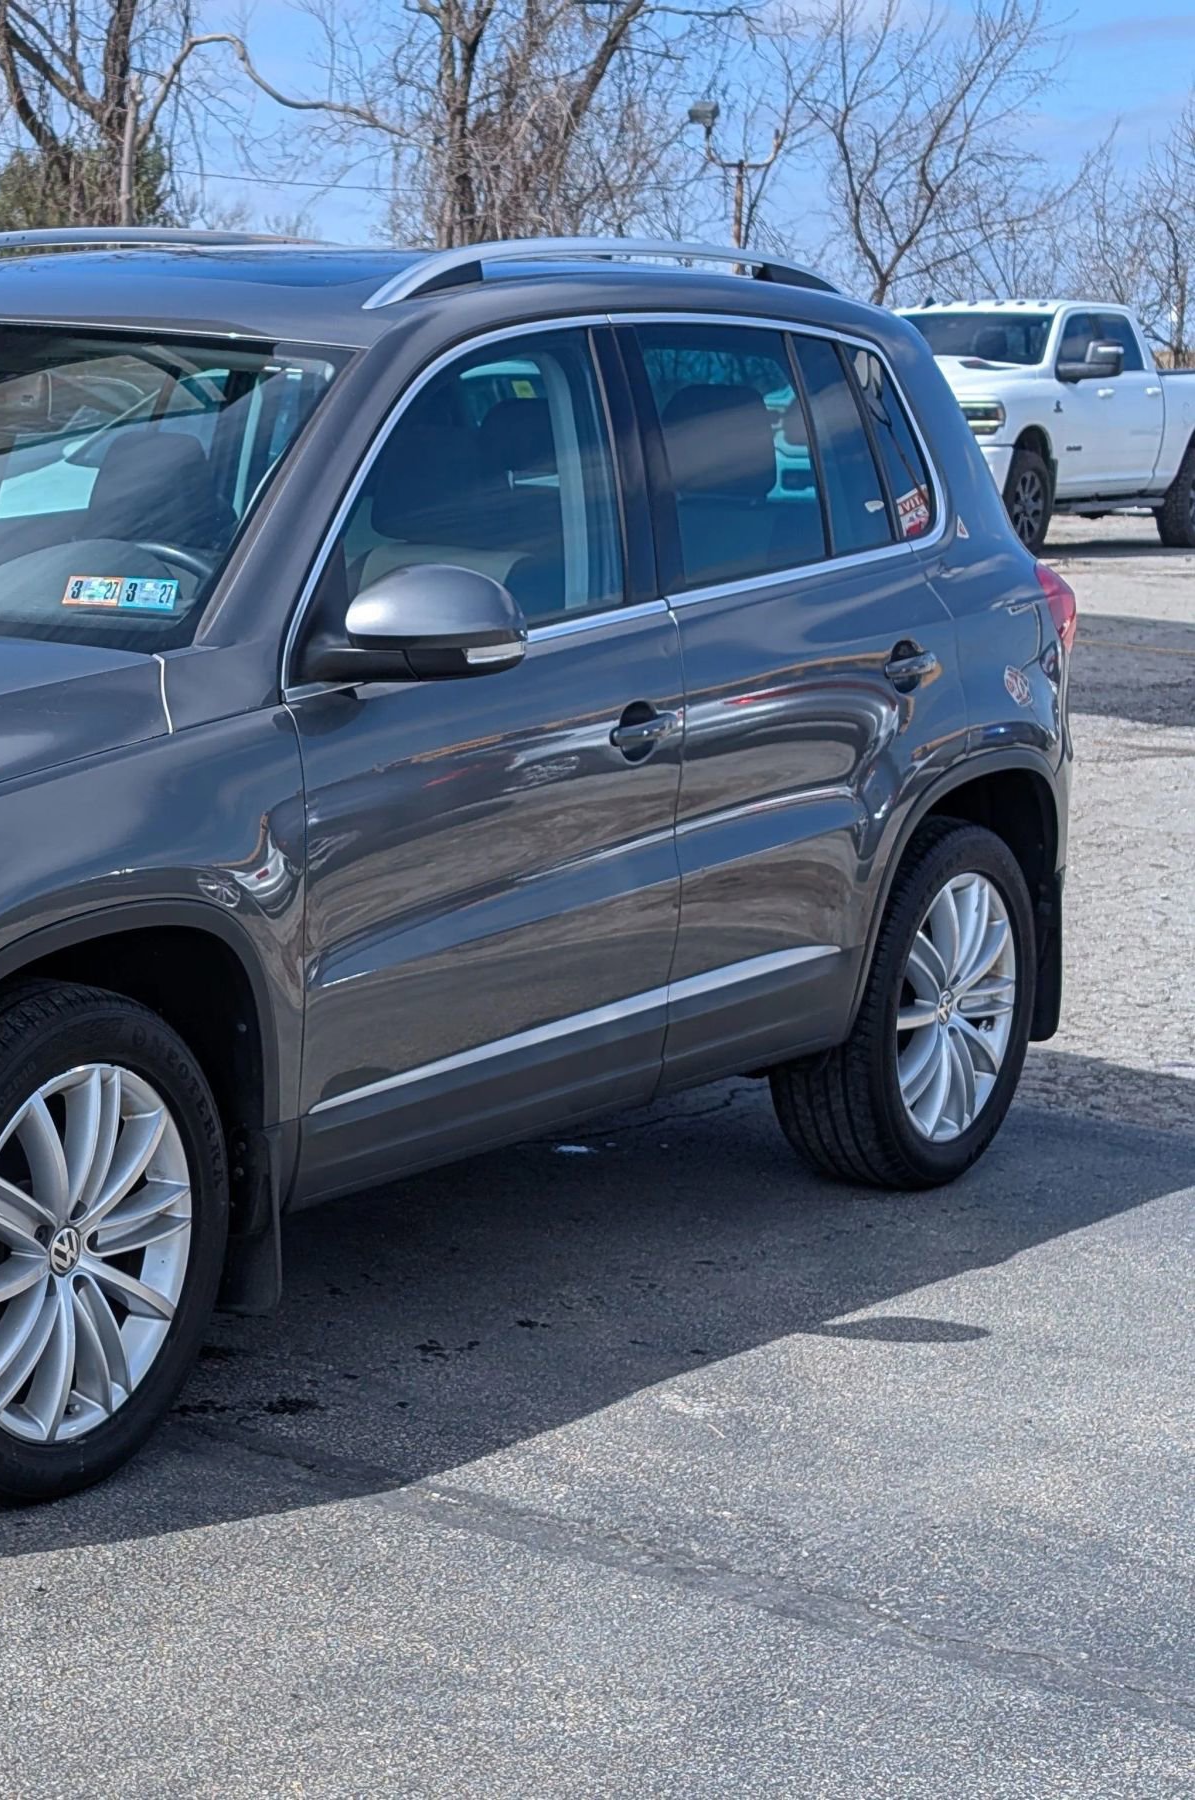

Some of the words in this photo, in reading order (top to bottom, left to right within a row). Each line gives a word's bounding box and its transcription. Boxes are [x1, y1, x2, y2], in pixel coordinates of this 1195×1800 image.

[70, 580, 84, 599] 3
[103, 581, 119, 600] 27
[125, 582, 138, 603] 3
[159, 583, 174, 604] 27
